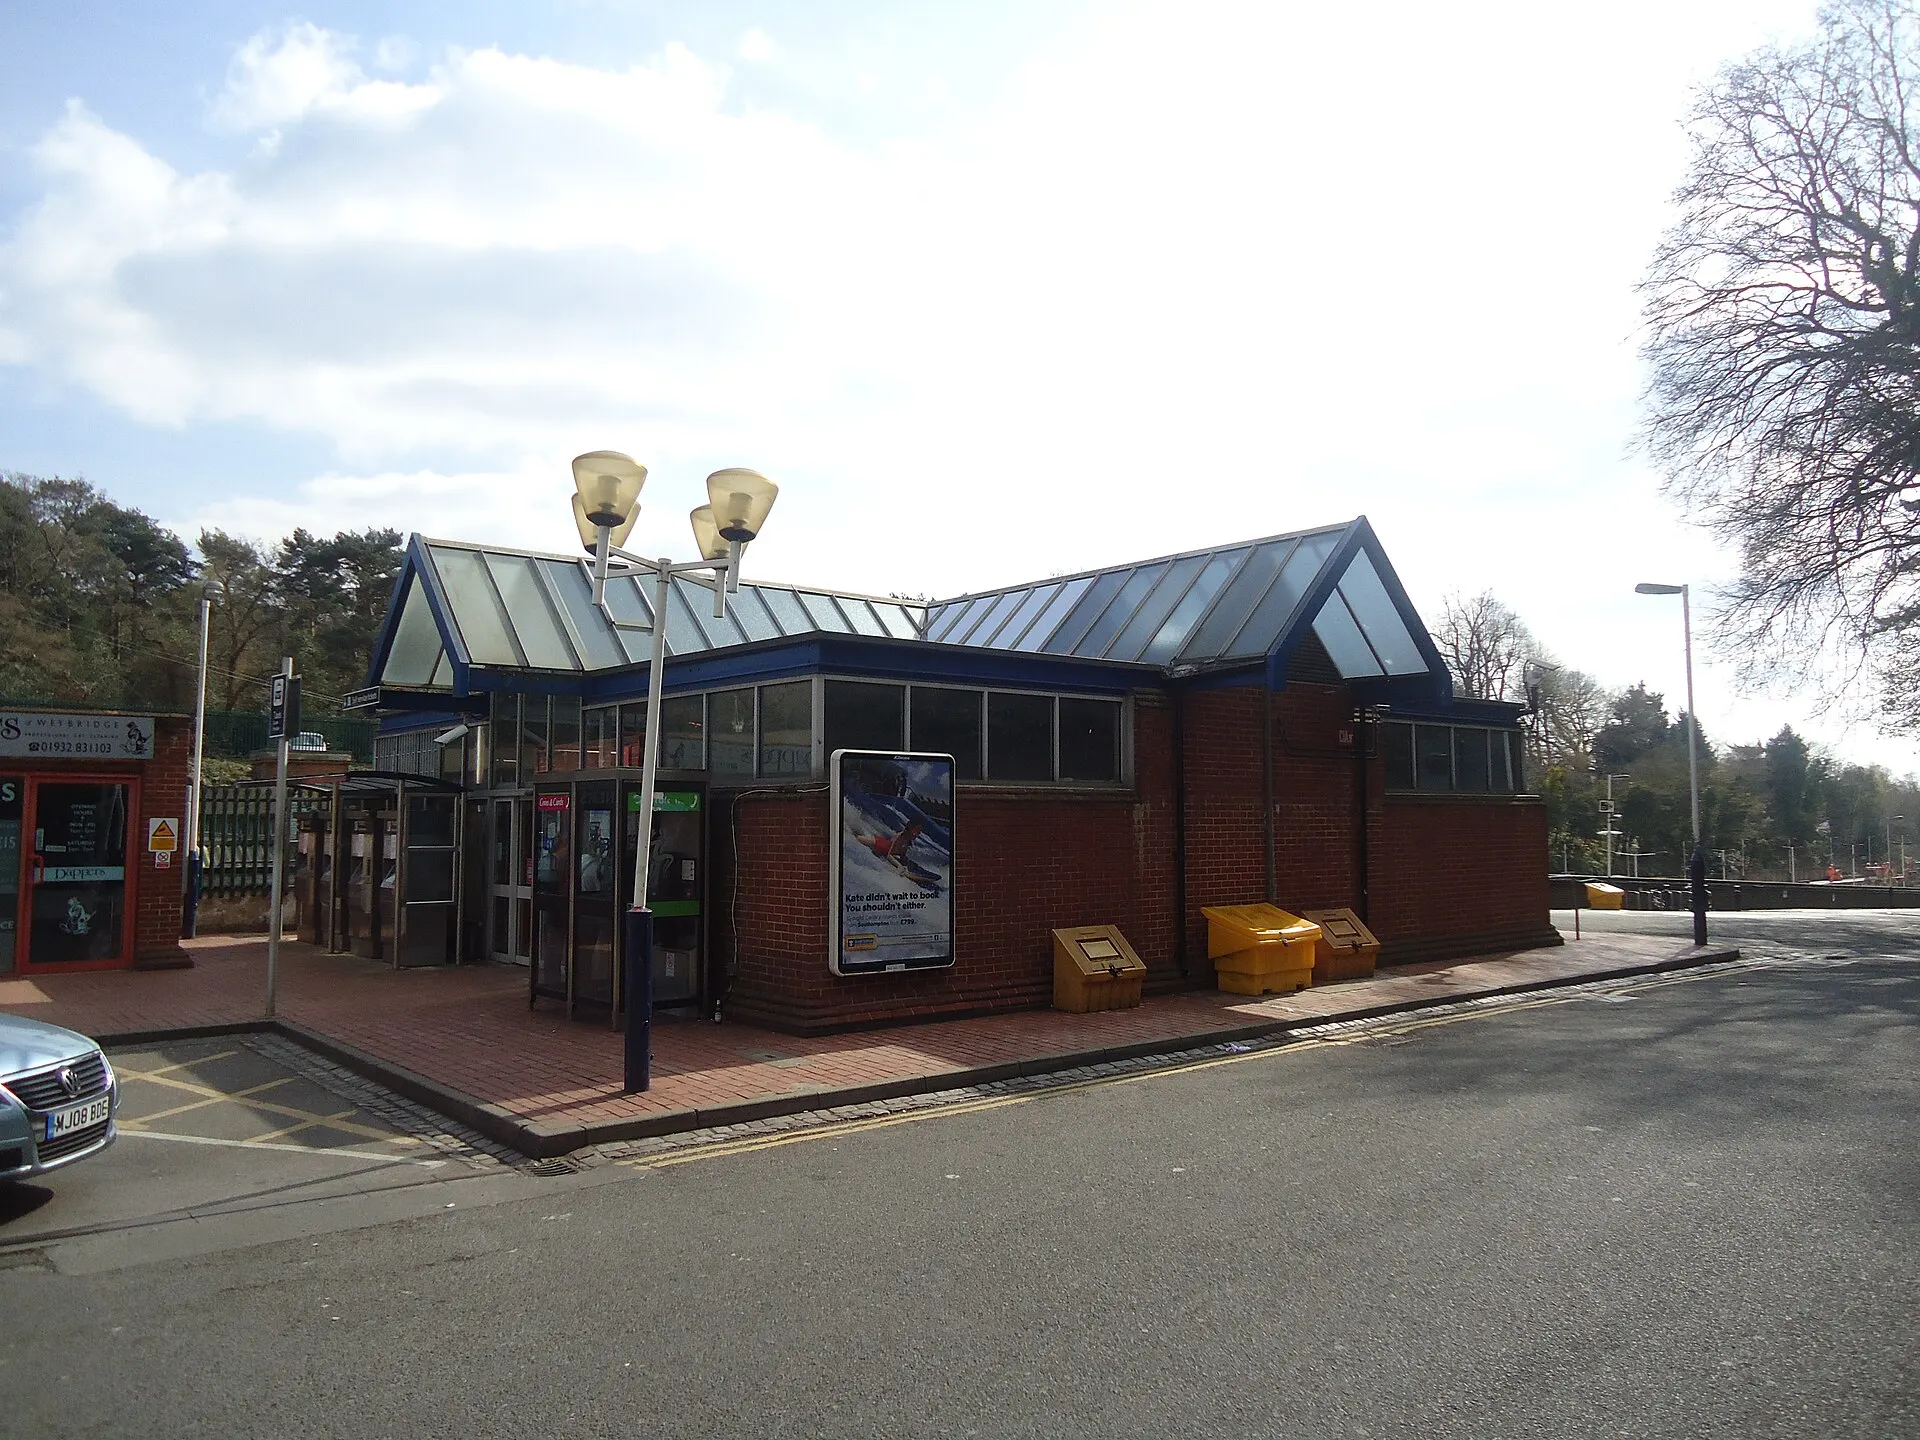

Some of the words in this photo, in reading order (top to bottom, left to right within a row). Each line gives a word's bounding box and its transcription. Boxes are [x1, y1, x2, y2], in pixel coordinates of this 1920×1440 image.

[37, 719, 119, 729] WEYBRIDGE
[41, 742, 72, 752] 01932
[75, 742, 112, 753] 831103
[55, 868, 105, 880] Dappers
[846, 894, 864, 902] Kate
[866, 893, 890, 901] didn't
[892, 892, 909, 900] wait
[846, 904, 861, 912] You
[862, 902, 901, 912] shouldn't
[902, 901, 927, 910] either.
[90, 1099, 108, 1121] BDE
